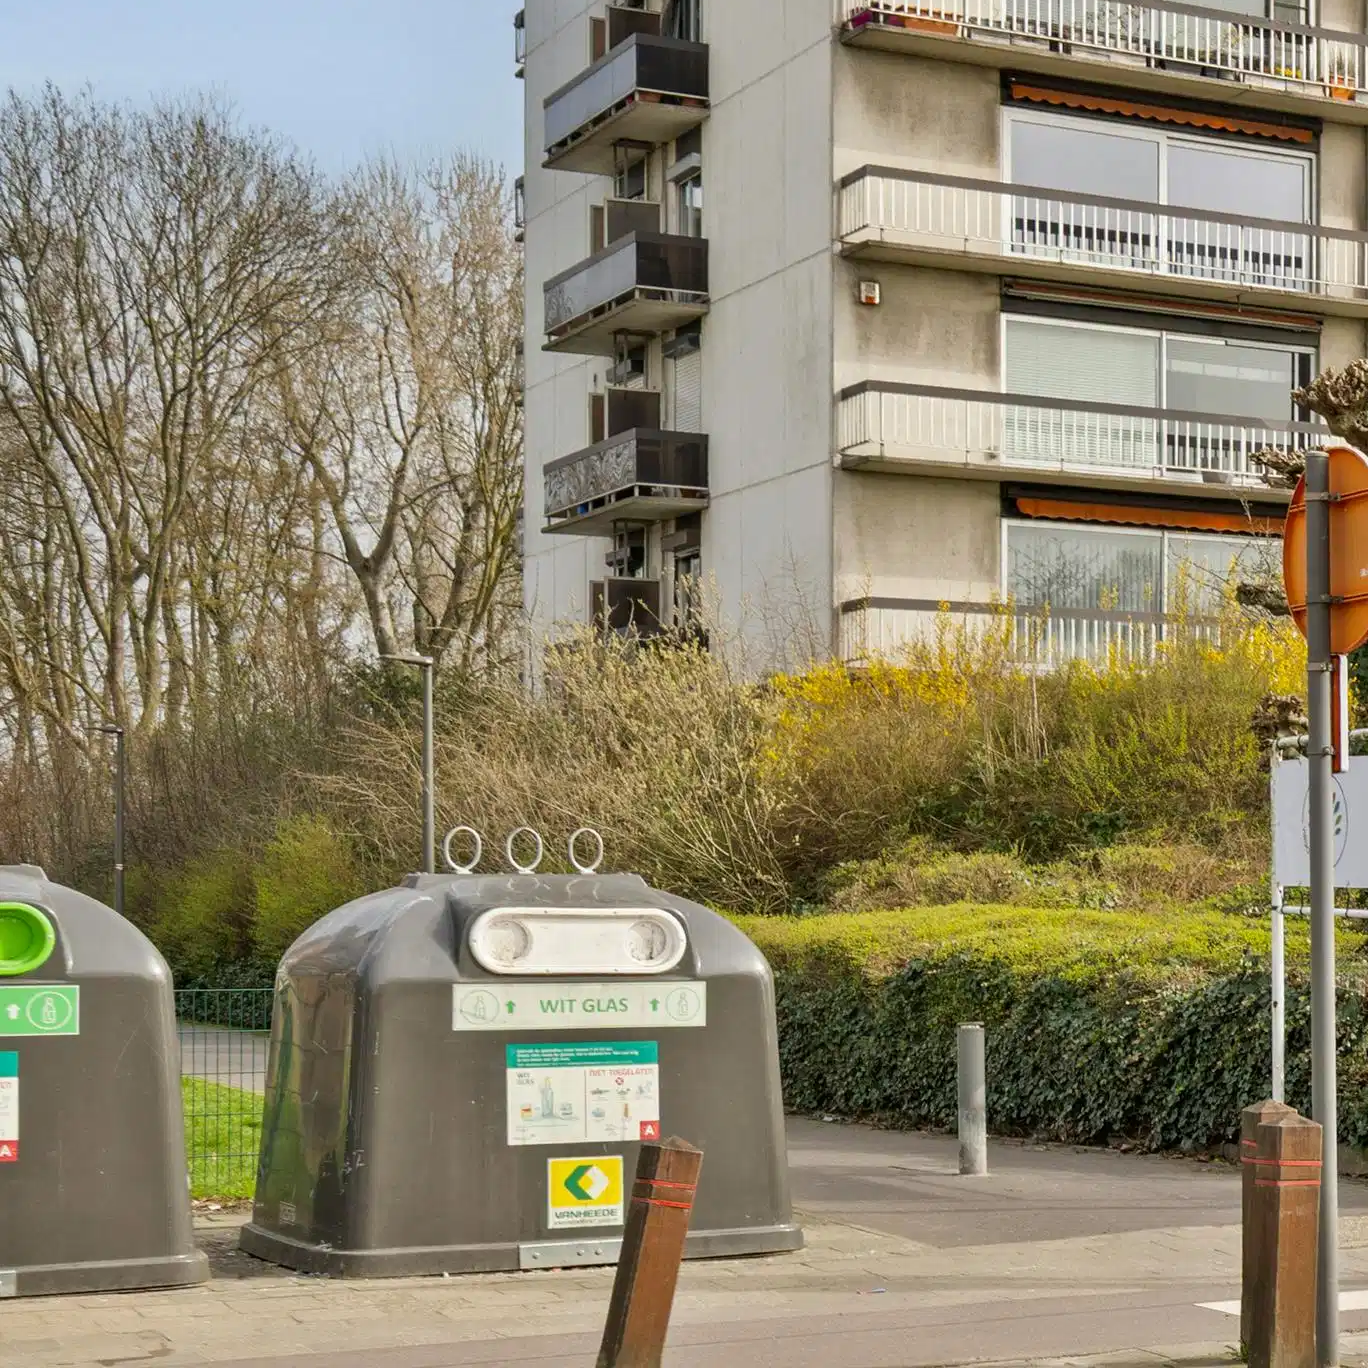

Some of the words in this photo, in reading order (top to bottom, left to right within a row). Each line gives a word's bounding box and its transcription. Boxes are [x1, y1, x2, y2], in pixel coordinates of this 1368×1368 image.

[539, 998, 577, 1014] WIT
[582, 998, 629, 1013] GLAS
[645, 1124, 656, 1136] A
